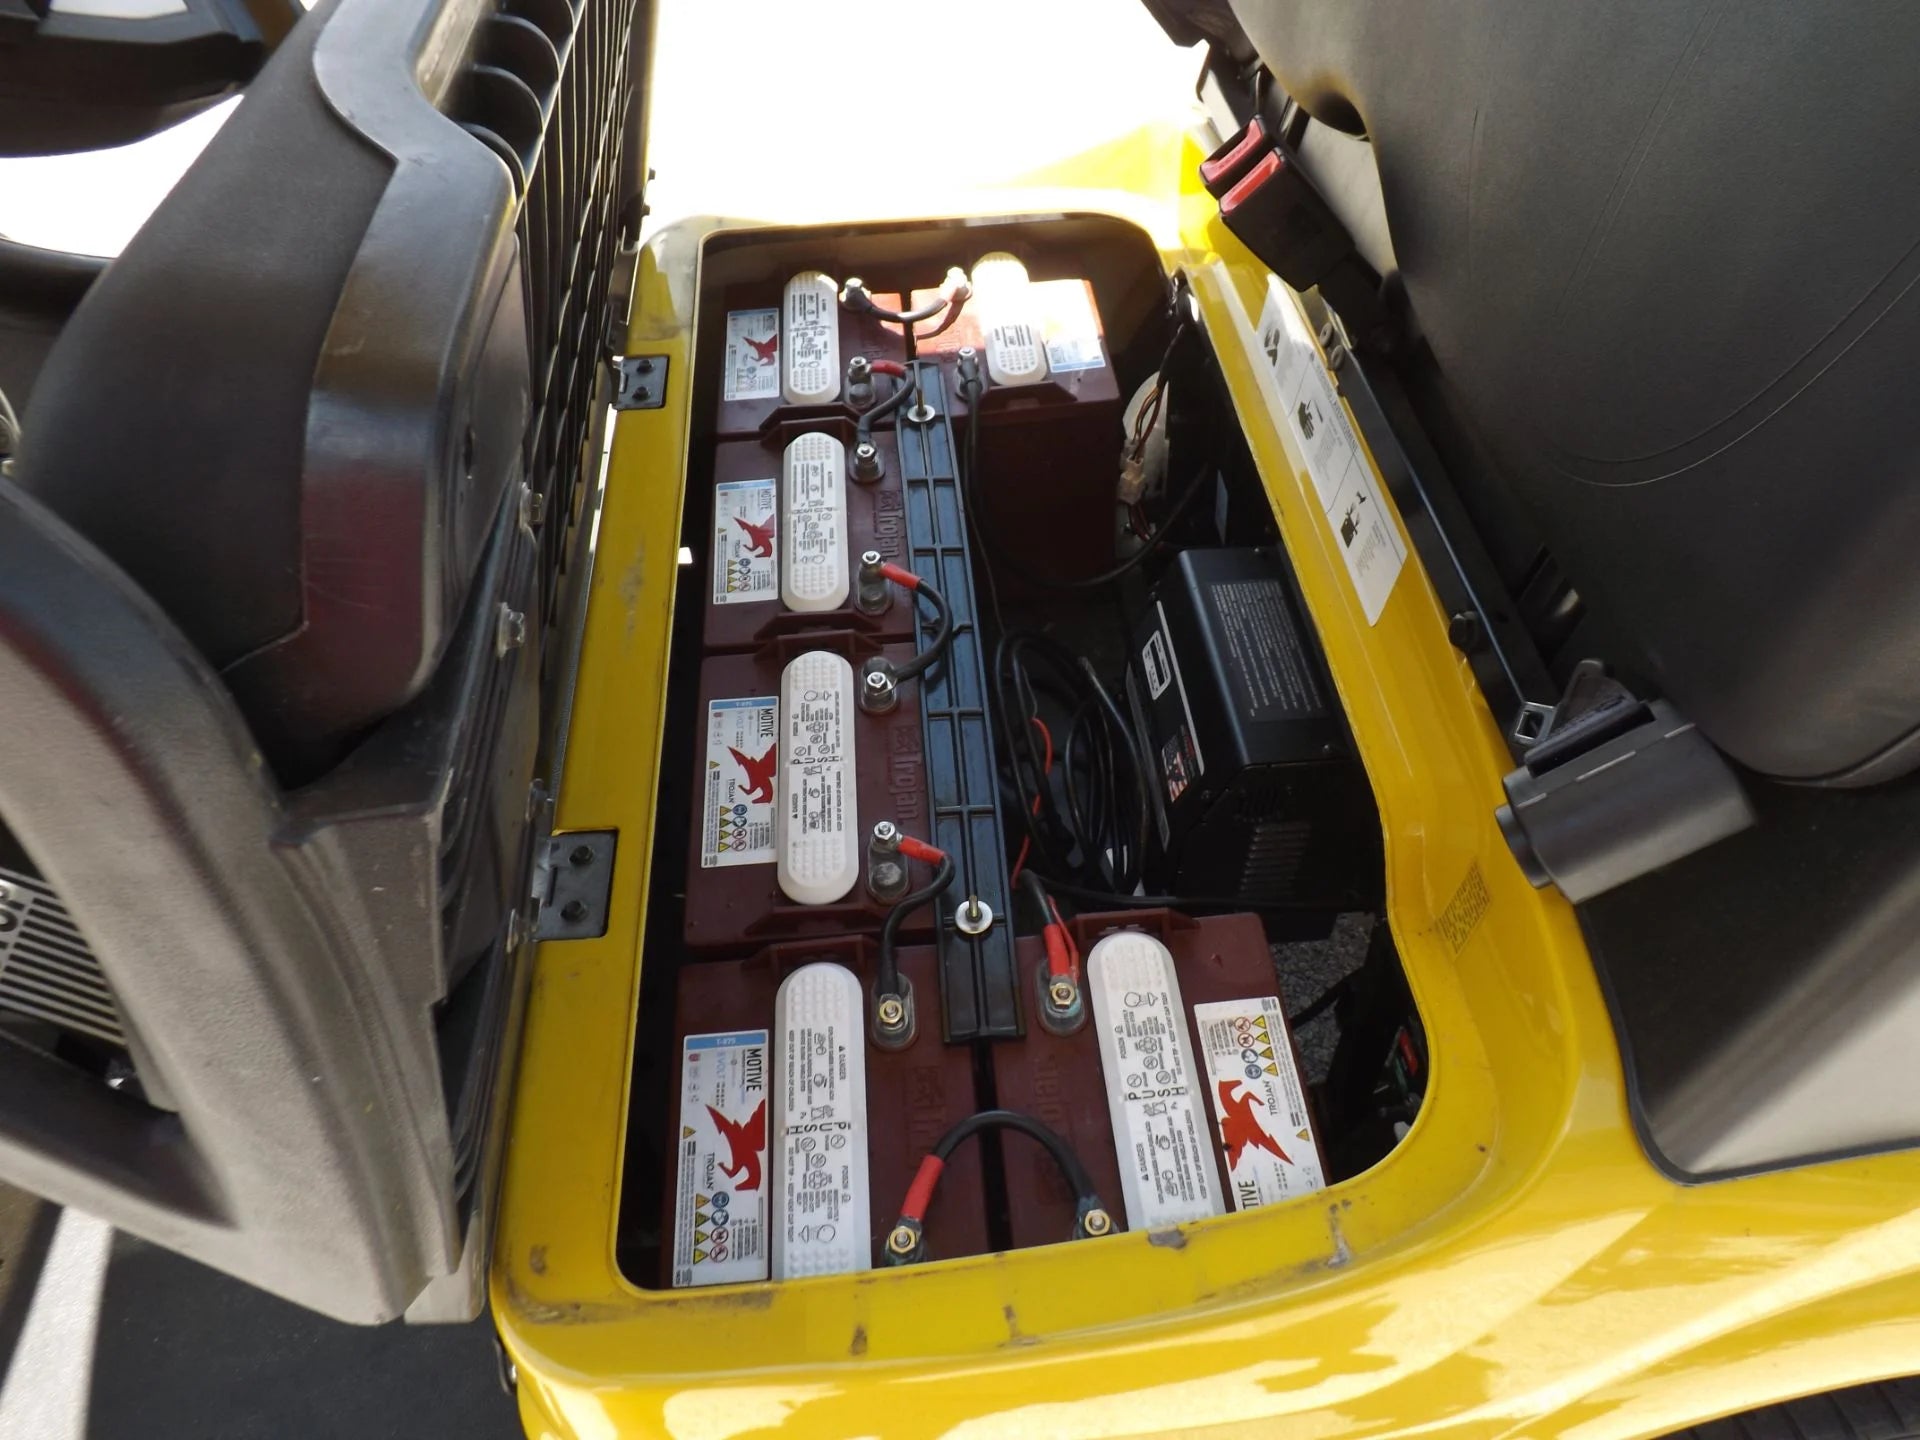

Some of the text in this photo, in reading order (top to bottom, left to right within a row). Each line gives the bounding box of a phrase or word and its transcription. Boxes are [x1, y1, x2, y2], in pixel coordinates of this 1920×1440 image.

[760, 708, 774, 738] MOTIVE
[791, 755, 839, 765] PUSH
[727, 778, 736, 804] TROJAN
[889, 751, 923, 820] Trojan
[746, 1048, 762, 1092] MOTIVE
[1127, 1086, 1186, 1101] PUSH
[1264, 1081, 1278, 1116] TROJAN
[789, 1121, 847, 1135] PUSH
[705, 1152, 715, 1189] TROJAN
[1238, 1180, 1260, 1210] TIVE
